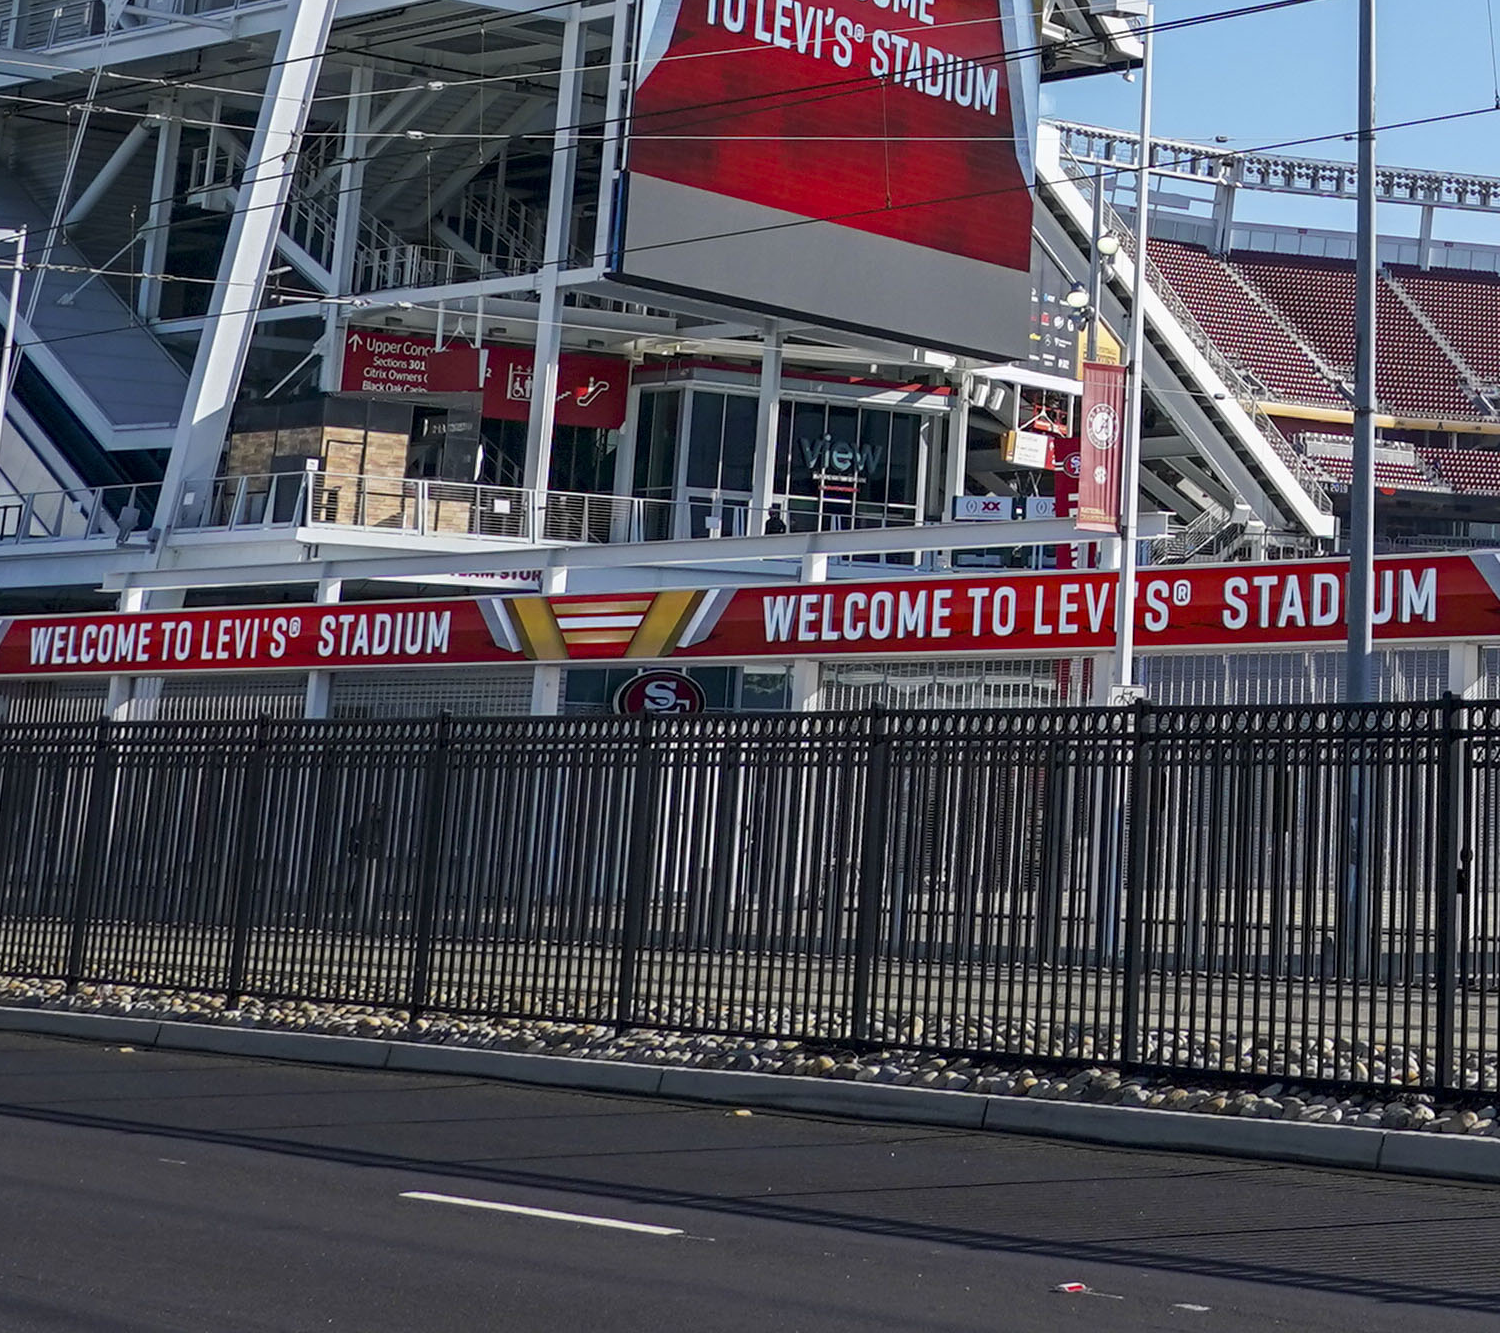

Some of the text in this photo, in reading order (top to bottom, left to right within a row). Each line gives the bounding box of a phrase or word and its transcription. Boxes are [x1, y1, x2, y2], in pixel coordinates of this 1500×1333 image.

[870, 29, 998, 115] STADIUM
[366, 337, 400, 356] Upper
[373, 355, 426, 371] Sections 301
[363, 367, 421, 383] Citrix Owners
[362, 380, 385, 392] Black
[799, 434, 882, 473] view
[982, 501, 1001, 512] XX
[763, 589, 953, 643] WELCOME
[967, 585, 1017, 637] TO
[1221, 567, 1437, 631] STADUM
[30, 621, 151, 665] WELCOME
[161, 620, 190, 661] TO
[317, 610, 451, 656] STADIUM
